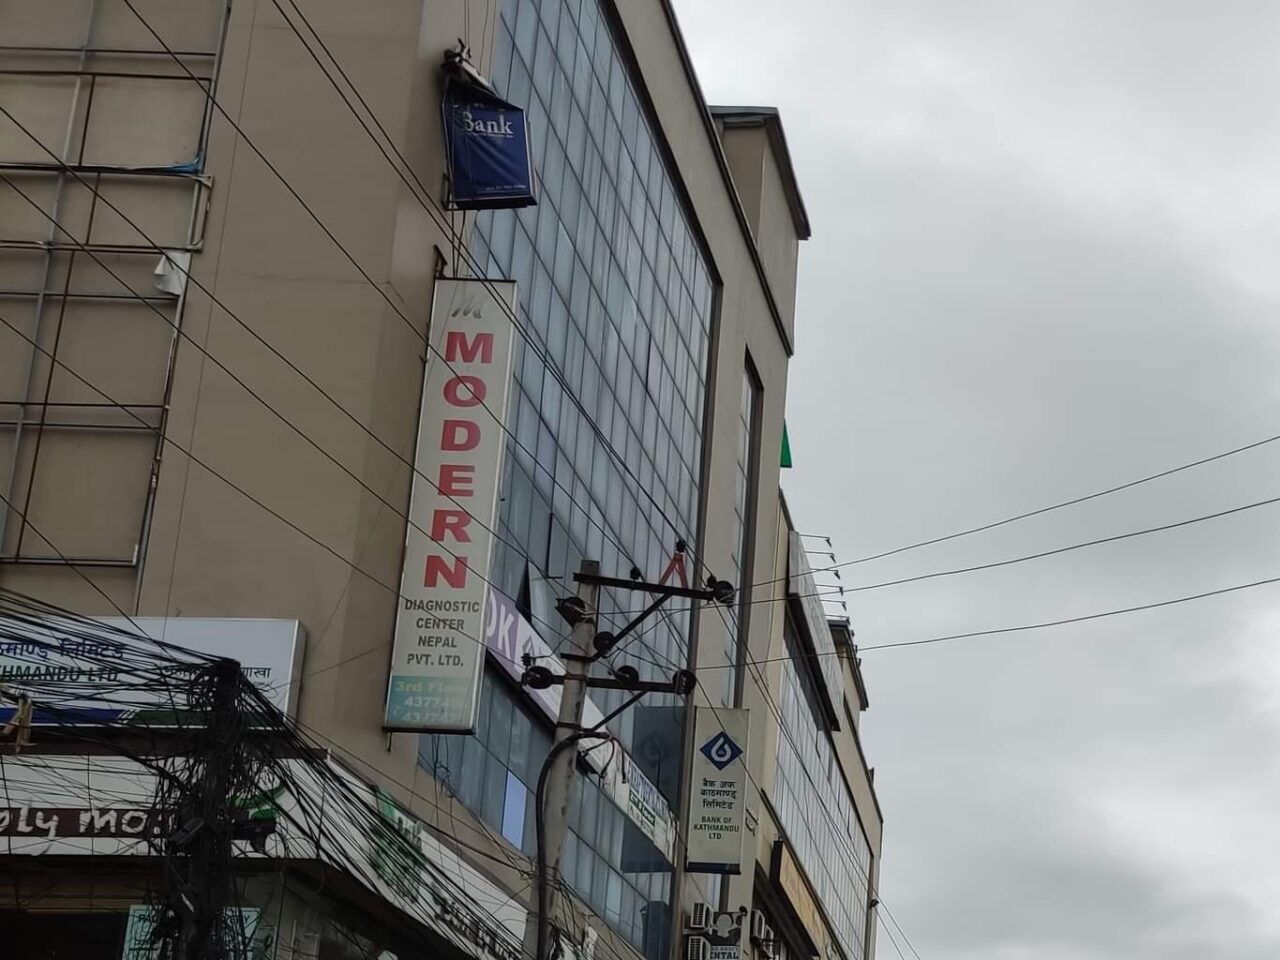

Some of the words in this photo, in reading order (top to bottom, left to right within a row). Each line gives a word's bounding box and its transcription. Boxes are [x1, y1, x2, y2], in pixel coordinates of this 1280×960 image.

[423, 330, 495, 590] MODERN
[404, 599, 480, 613] DIAGNOSTIC
[416, 618, 465, 631] CENTER
[418, 635, 458, 648] NEPAL
[406, 653, 434, 666] PVT.
[438, 654, 465, 667] LTD.
[701, 815, 722, 824] BANK
[723, 816, 733, 824] OF
[693, 823, 740, 833] KATHMANDU
[708, 832, 723, 840] LTD
[709, 951, 739, 960] ENTAL
